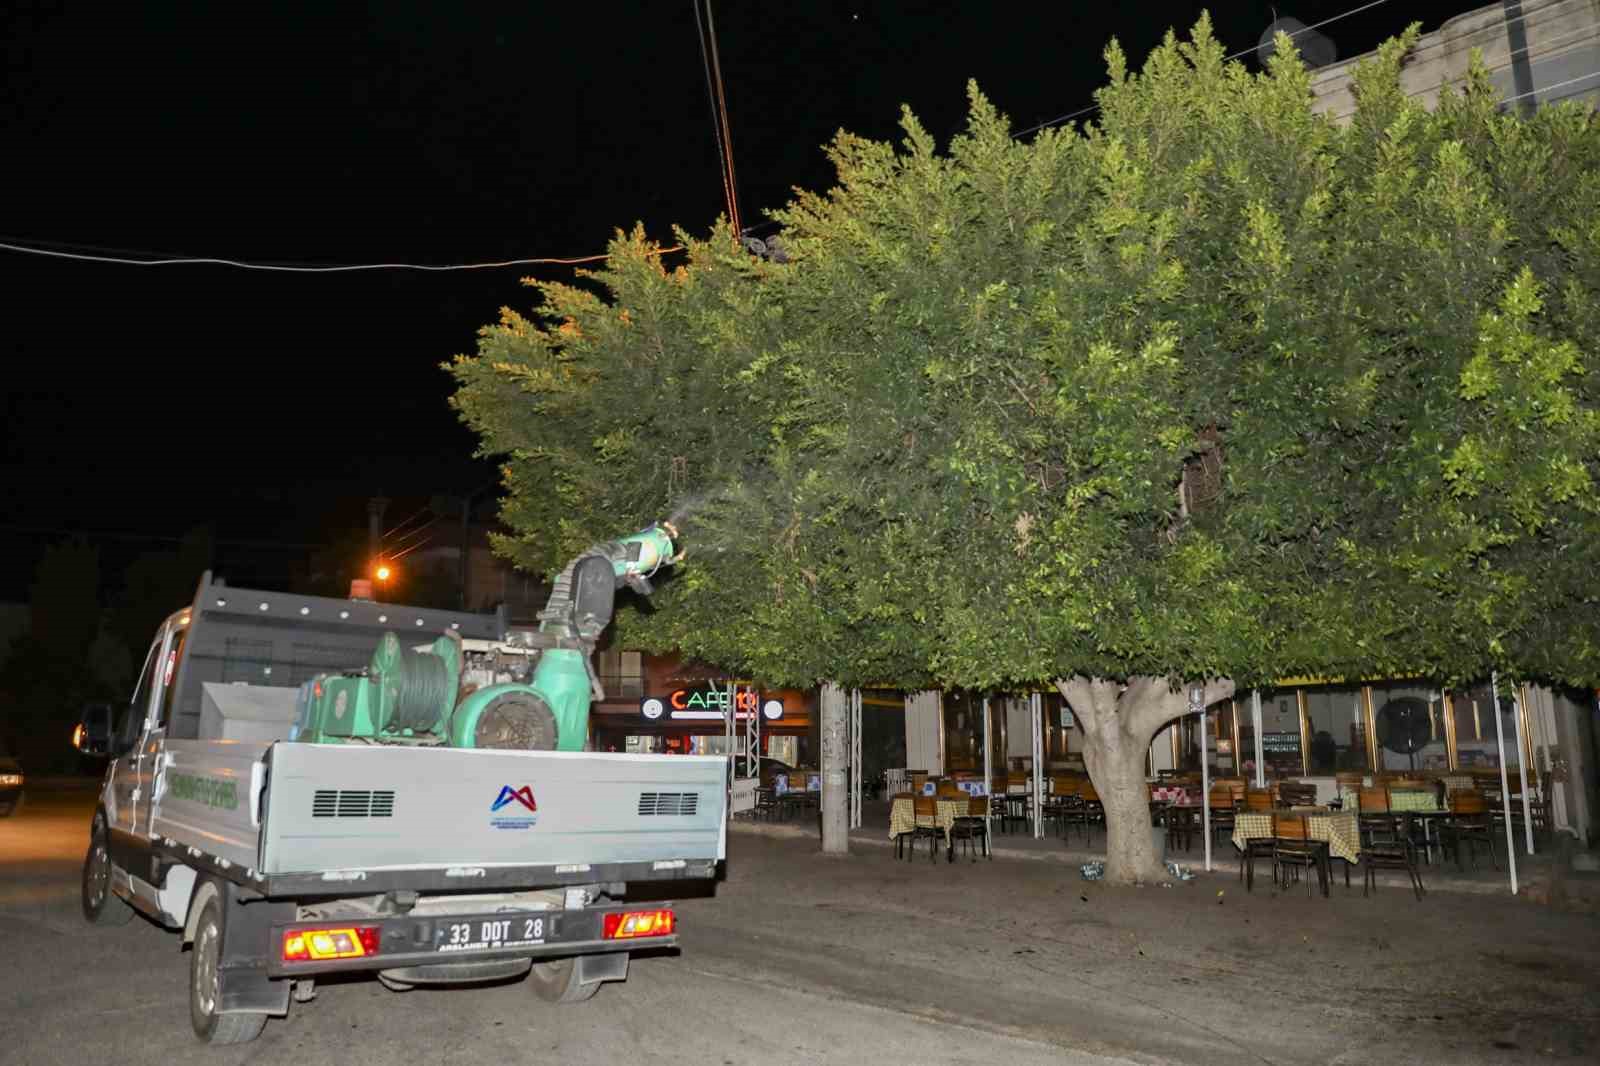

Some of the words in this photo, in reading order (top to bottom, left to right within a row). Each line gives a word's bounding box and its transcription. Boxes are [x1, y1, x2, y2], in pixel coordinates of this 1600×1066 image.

[450, 924, 470, 943] 33
[481, 921, 511, 941] DDT
[524, 918, 543, 939] 28
